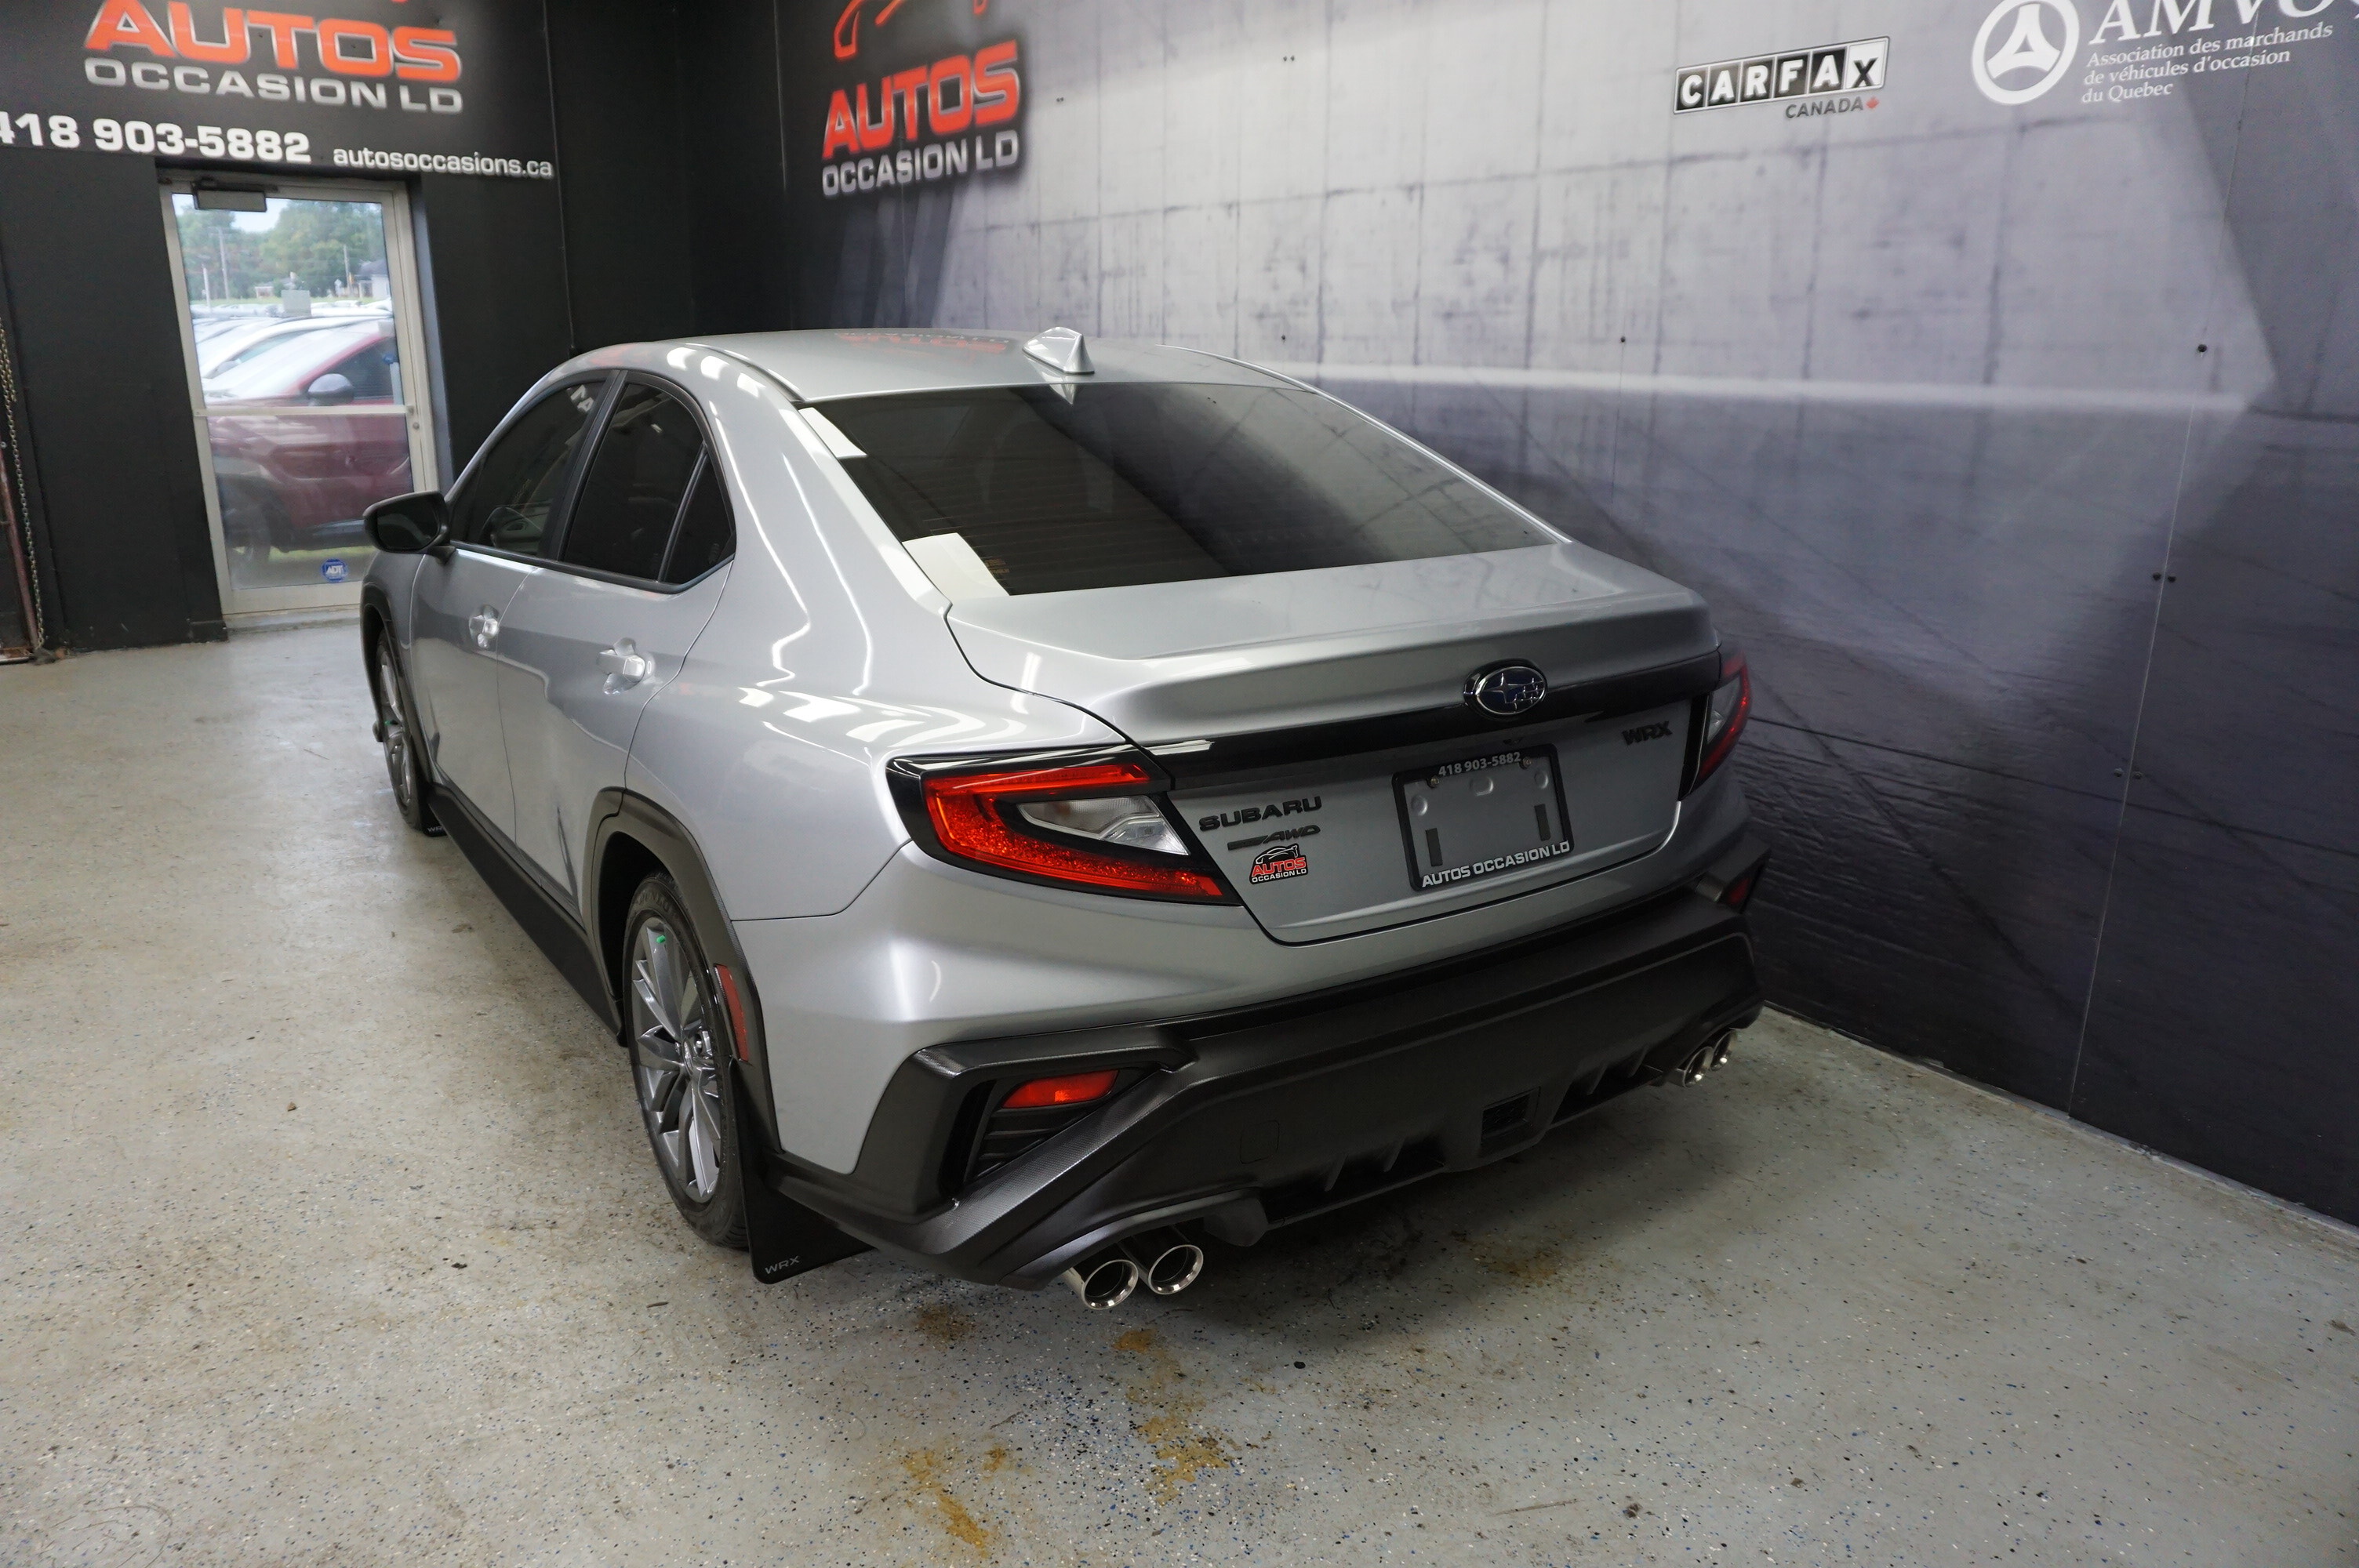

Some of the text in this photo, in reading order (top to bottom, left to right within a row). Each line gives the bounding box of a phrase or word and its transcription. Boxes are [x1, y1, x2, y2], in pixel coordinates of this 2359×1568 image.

[84, 0, 462, 82] AUTOS
[2086, 20, 2333, 67] Association des marchands
[1680, 54, 1879, 107] CARFAX
[2084, 49, 2291, 85] de véhicules d'occasion
[84, 57, 463, 114] OCCASION LD
[822, 38, 1020, 160] AUTOS
[2081, 81, 2174, 103] du Quebec
[1785, 96, 1864, 118] CANADA
[93, 118, 312, 165] 903-5882
[333, 147, 554, 180] autosoccasions.ca
[822, 129, 1019, 197] OCCASION LD
[1621, 720, 1673, 746] WRX
[1438, 751, 1521, 776] 418 903-5882
[1198, 795, 1323, 832] SUBARU
[1262, 824, 1321, 844] AWD
[1252, 856, 1307, 878] AUTOS
[1252, 869, 1296, 883] OCCASION
[1422, 840, 1570, 888] AUTOS OCCASION LD
[764, 1254, 801, 1275] WRX
